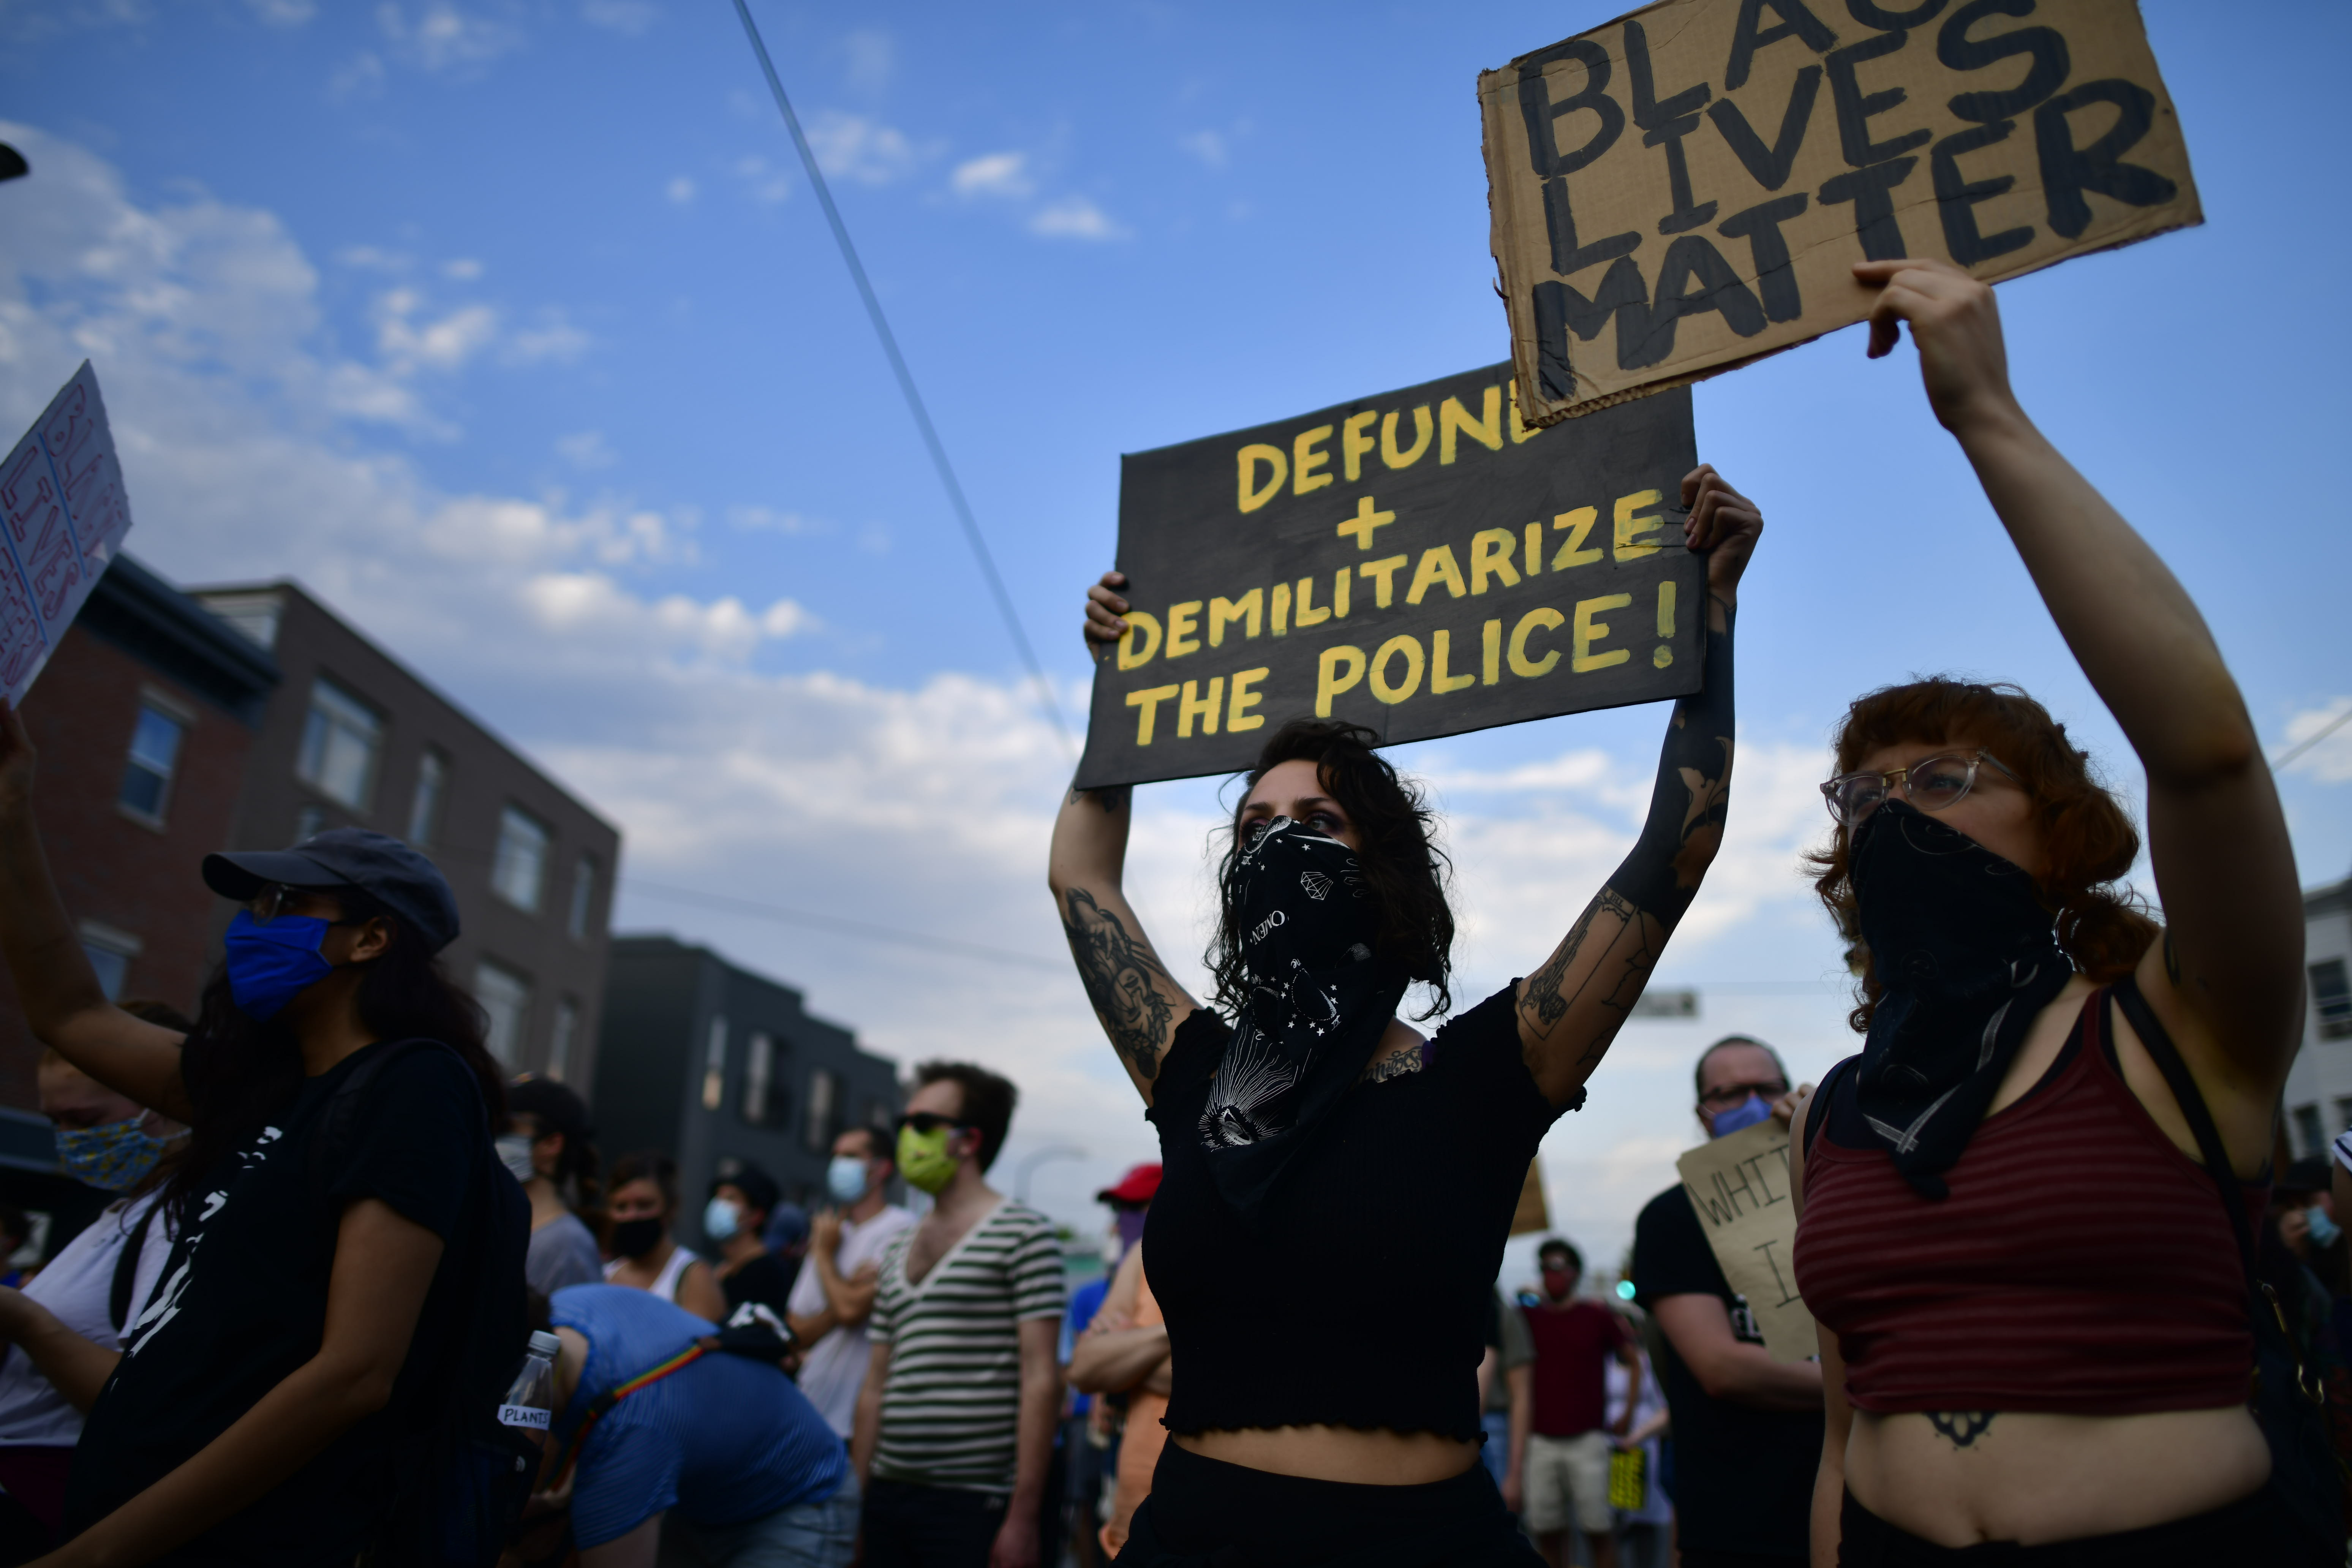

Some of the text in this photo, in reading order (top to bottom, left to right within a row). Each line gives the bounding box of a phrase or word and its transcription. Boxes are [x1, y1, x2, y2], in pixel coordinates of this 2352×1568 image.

[1542, 0, 2071, 275] LIVES
[1533, 78, 2177, 401] MATTER
[1, 446, 78, 621] LIVES
[44, 384, 123, 578] BLACK
[1337, 496, 1395, 550] +
[1117, 488, 1665, 670] DEMILITARIZE
[1125, 666, 1270, 746] THE
[1250, 909, 1285, 945] OMEN
[504, 1408, 548, 1424] PLANTS
